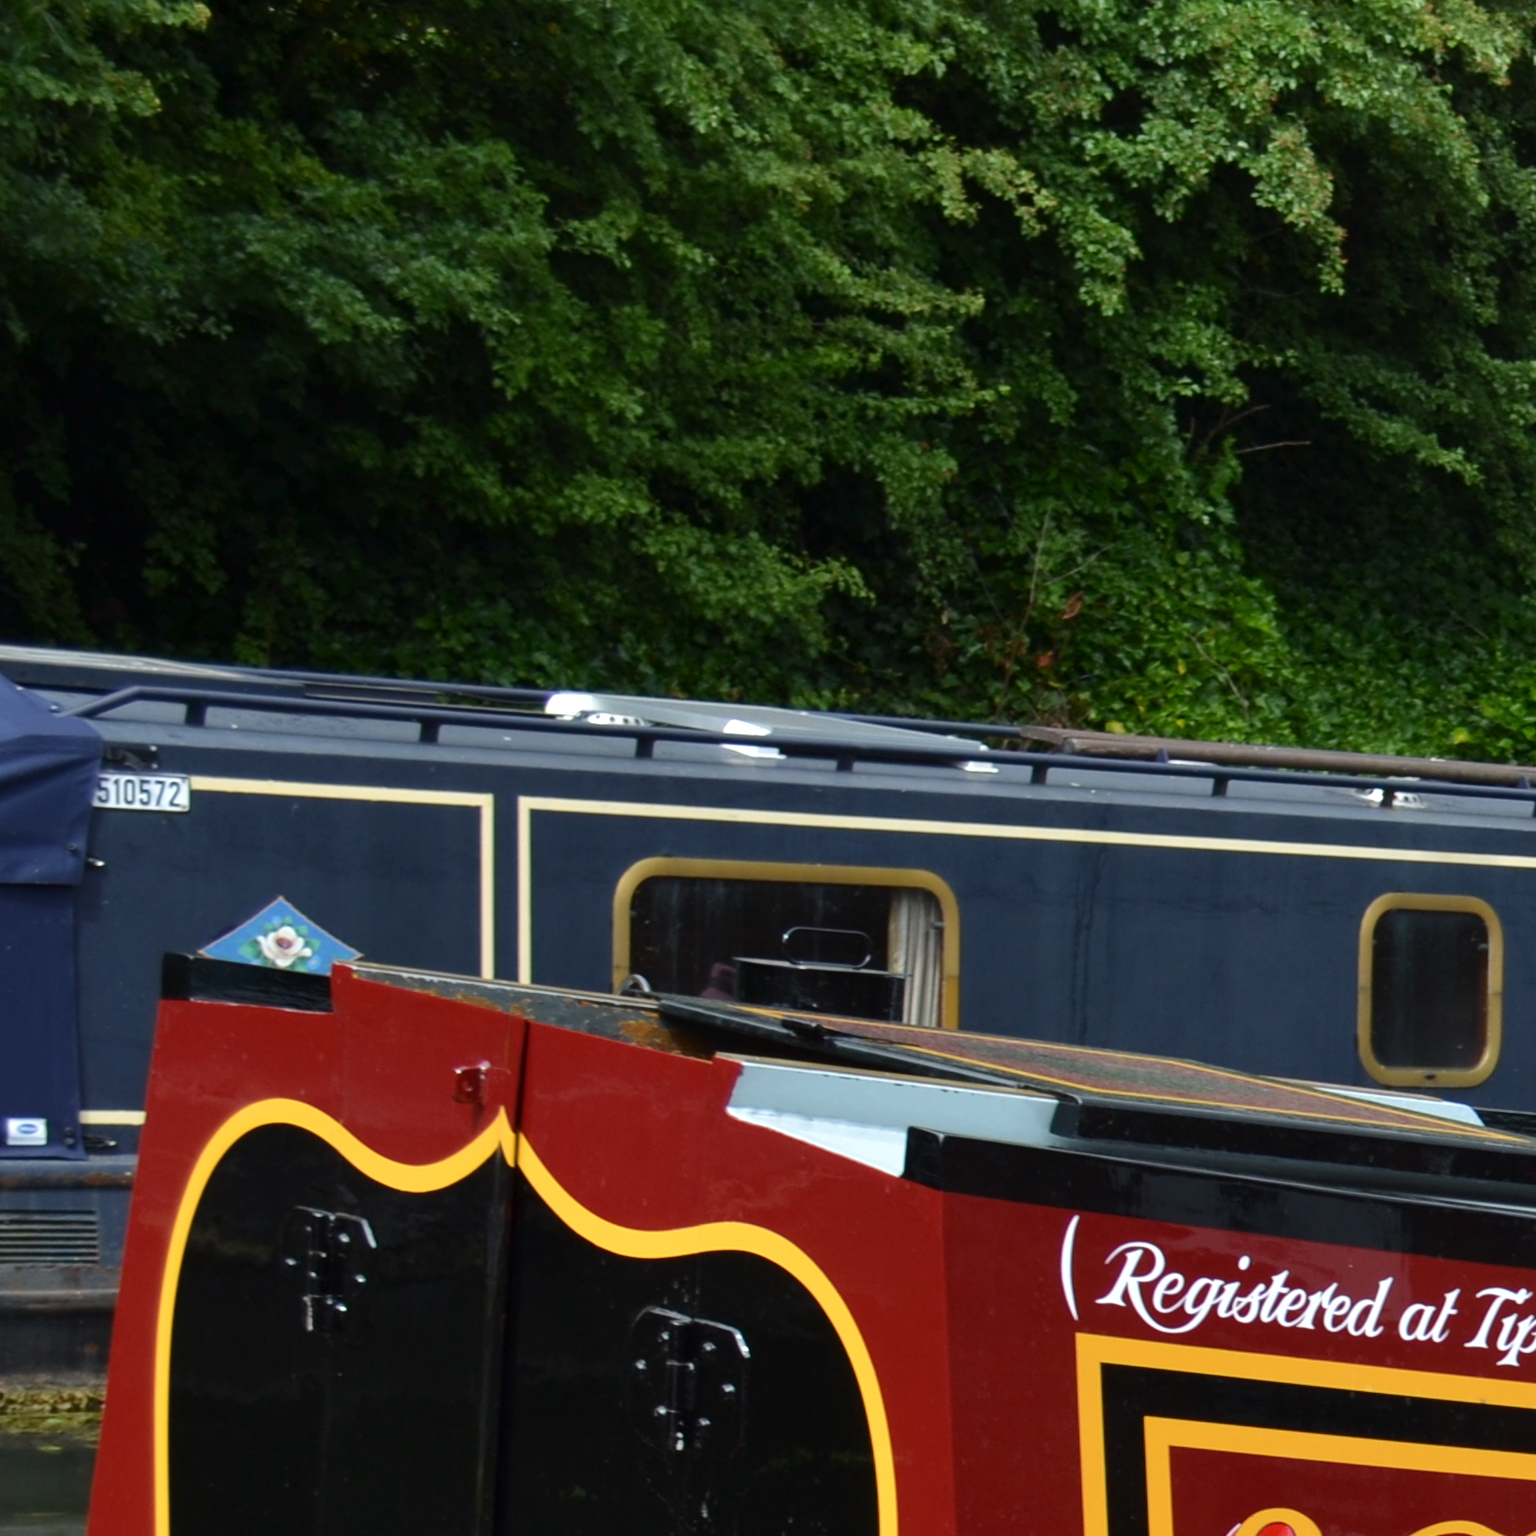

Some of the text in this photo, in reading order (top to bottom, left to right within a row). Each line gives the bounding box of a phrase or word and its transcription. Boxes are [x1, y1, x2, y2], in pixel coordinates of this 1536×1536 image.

[98, 776, 182, 807] 510572
[1060, 1214, 1396, 1336] (Registered
[1398, 1287, 1459, 1343] at
